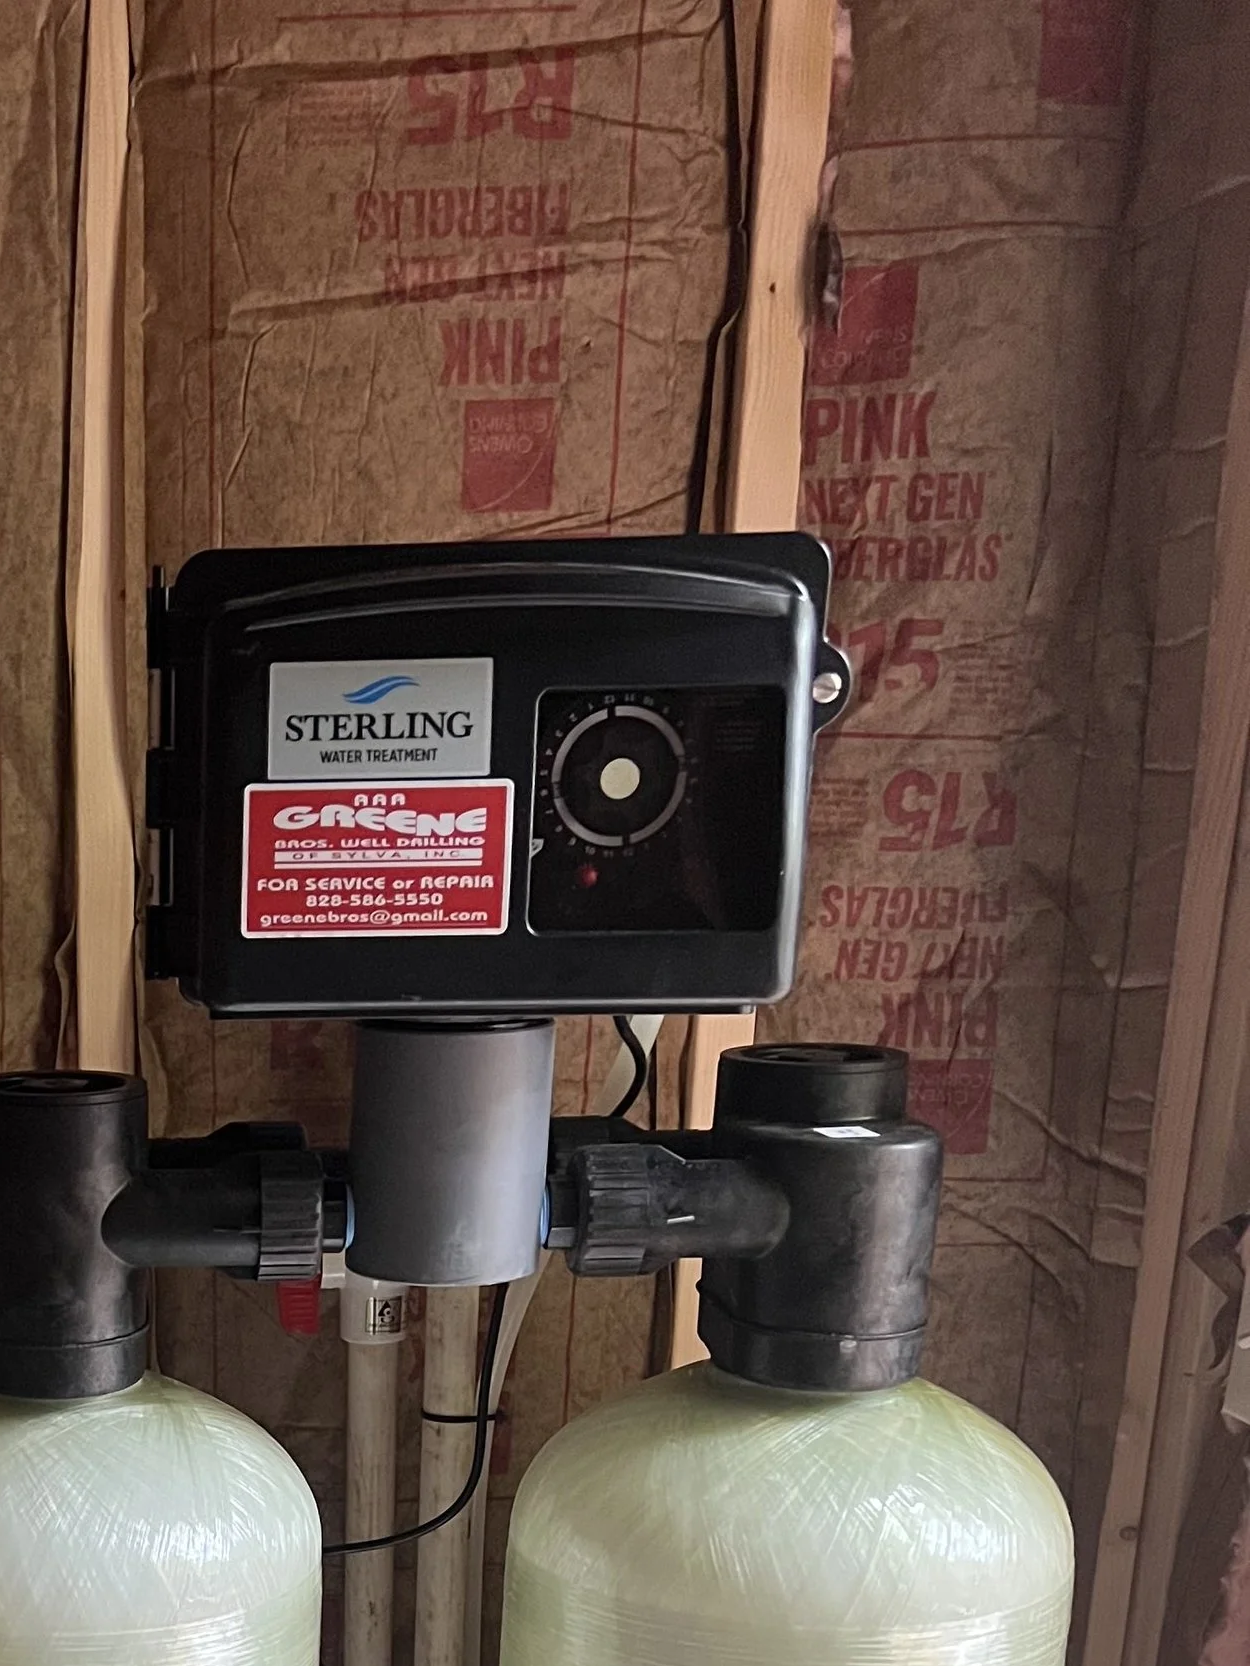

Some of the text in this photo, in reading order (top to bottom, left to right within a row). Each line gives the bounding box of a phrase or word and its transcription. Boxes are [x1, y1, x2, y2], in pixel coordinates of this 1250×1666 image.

[406, 47, 577, 147] R15
[356, 183, 570, 243] FIBERGLAS
[469, 251, 566, 303] NEXT
[437, 317, 562, 388] PINK
[803, 389, 937, 467] PINK
[804, 471, 986, 526] NEXT GEN
[285, 711, 474, 742] STERLING
[320, 747, 439, 764] WATER TREATMENT
[272, 804, 488, 837] GREENE
[878, 768, 1019, 852] R15
[274, 836, 486, 849] BROS. WELL DRILLING
[256, 874, 494, 892] FOR SERVICE or REPAIR
[305, 892, 444, 907] 828-586-5550
[259, 909, 489, 927] greenebros@gmail.com
[833, 940, 908, 982] GEN
[879, 991, 998, 1050] PINK
